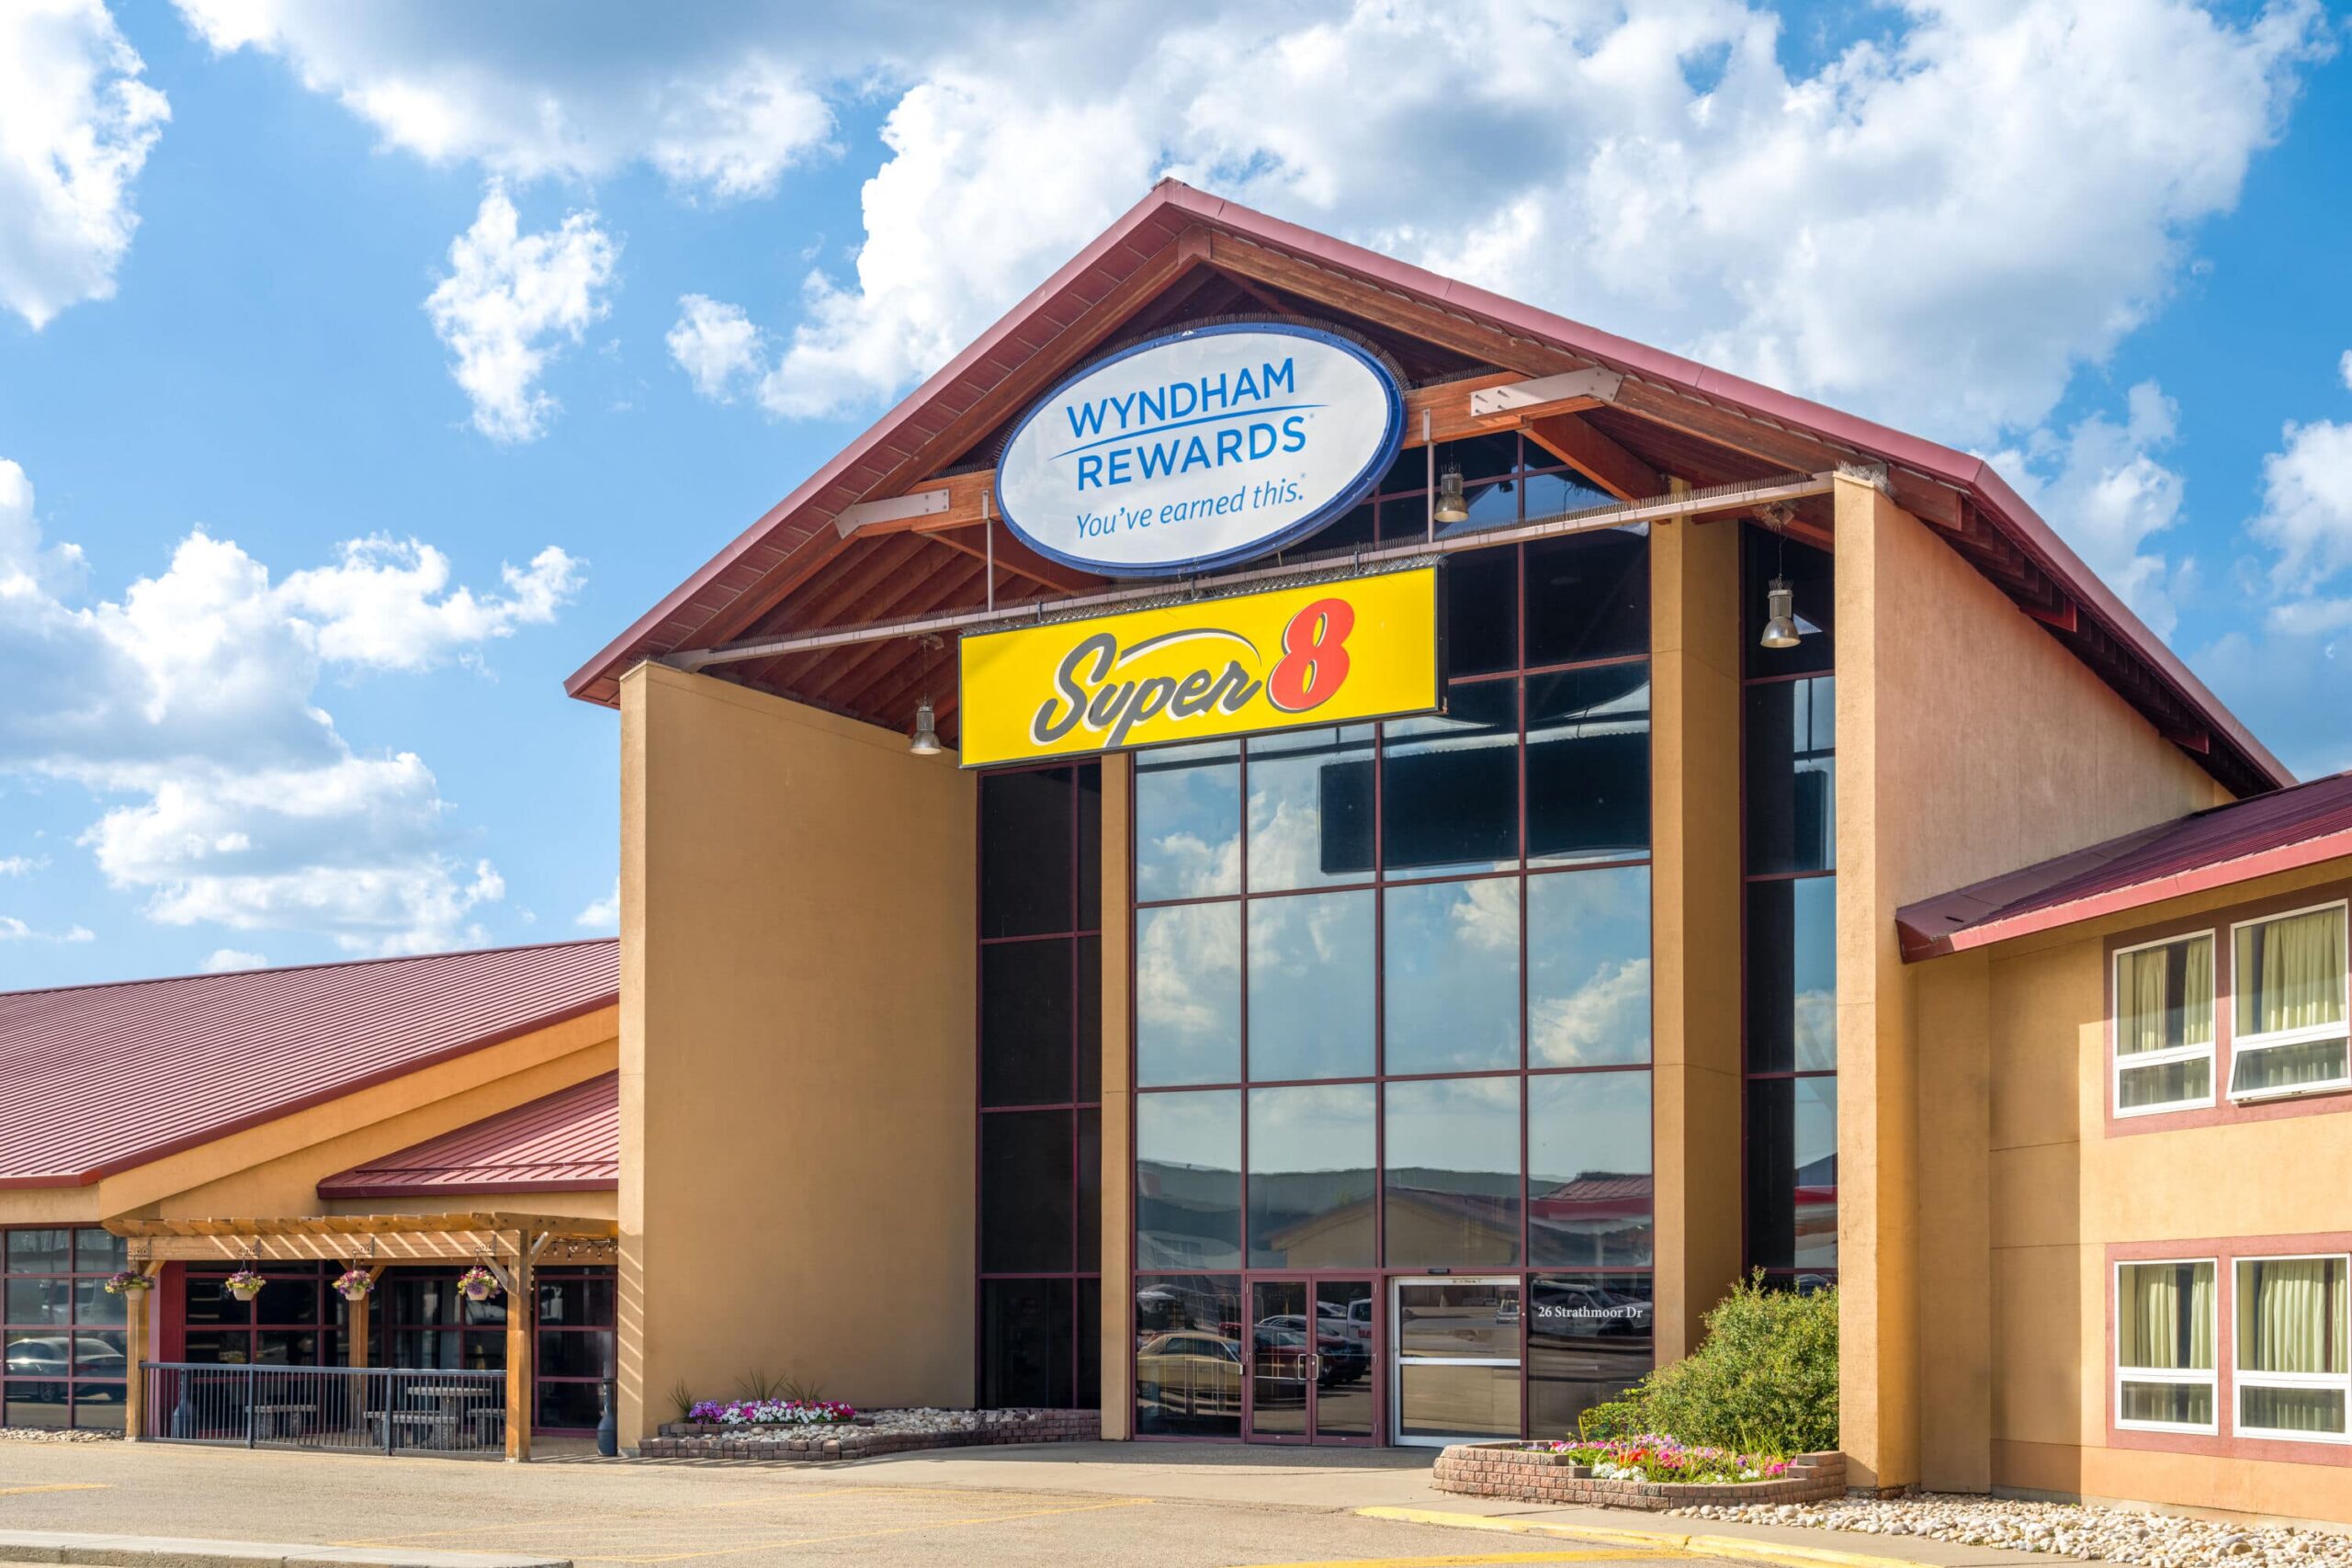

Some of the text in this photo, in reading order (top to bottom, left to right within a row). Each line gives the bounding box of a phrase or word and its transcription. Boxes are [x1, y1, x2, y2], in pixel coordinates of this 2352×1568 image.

[1067, 357, 1295, 438] WYNDHAM
[1078, 416, 1306, 491] REWARDS
[1077, 479, 1304, 538] You've earned this.
[1029, 598, 1355, 747] Super 8
[1538, 1305, 1643, 1318] 26 Strathmoor Dr
